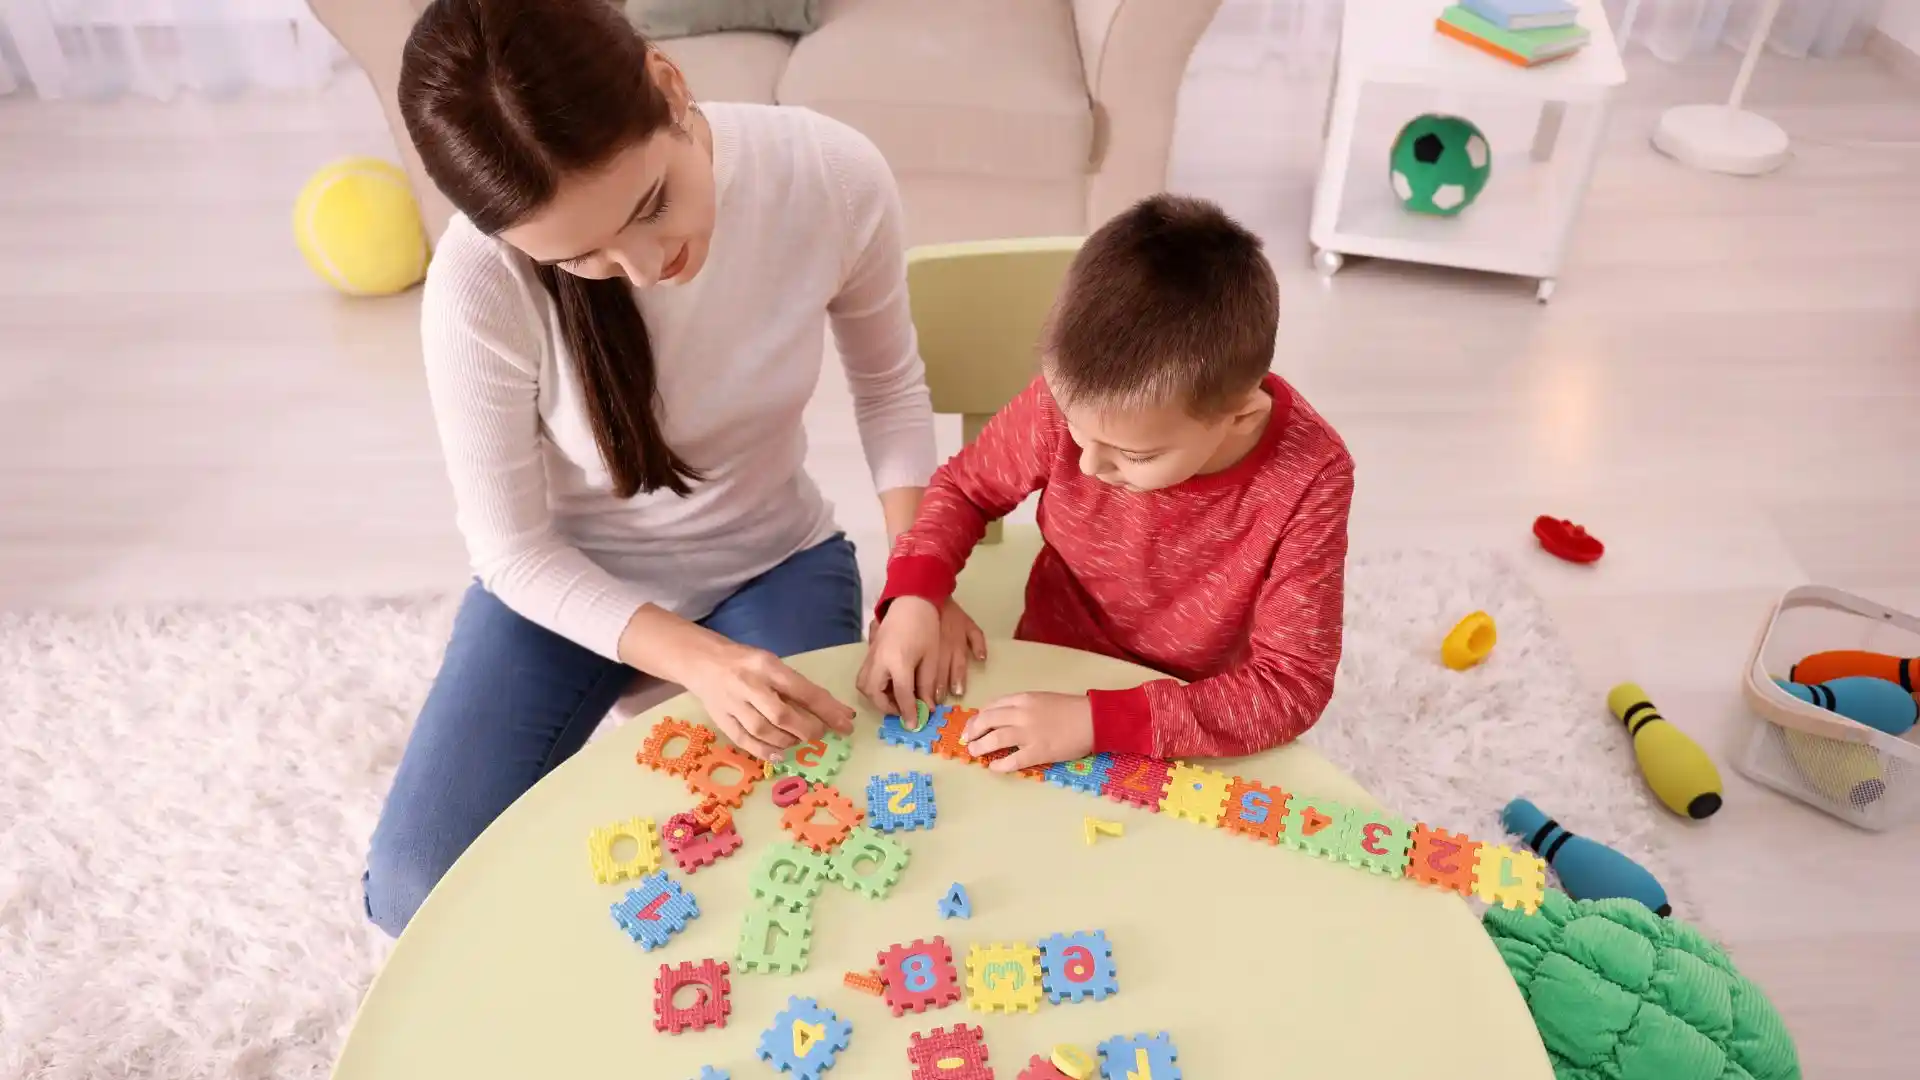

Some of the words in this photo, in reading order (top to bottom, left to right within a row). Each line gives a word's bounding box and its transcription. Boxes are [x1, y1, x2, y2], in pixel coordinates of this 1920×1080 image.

[1239, 791, 1272, 824] 5
[1300, 805, 1332, 836] 4
[1361, 822, 1392, 855] 3
[1428, 838, 1461, 874] 2
[901, 954, 937, 992] 8
